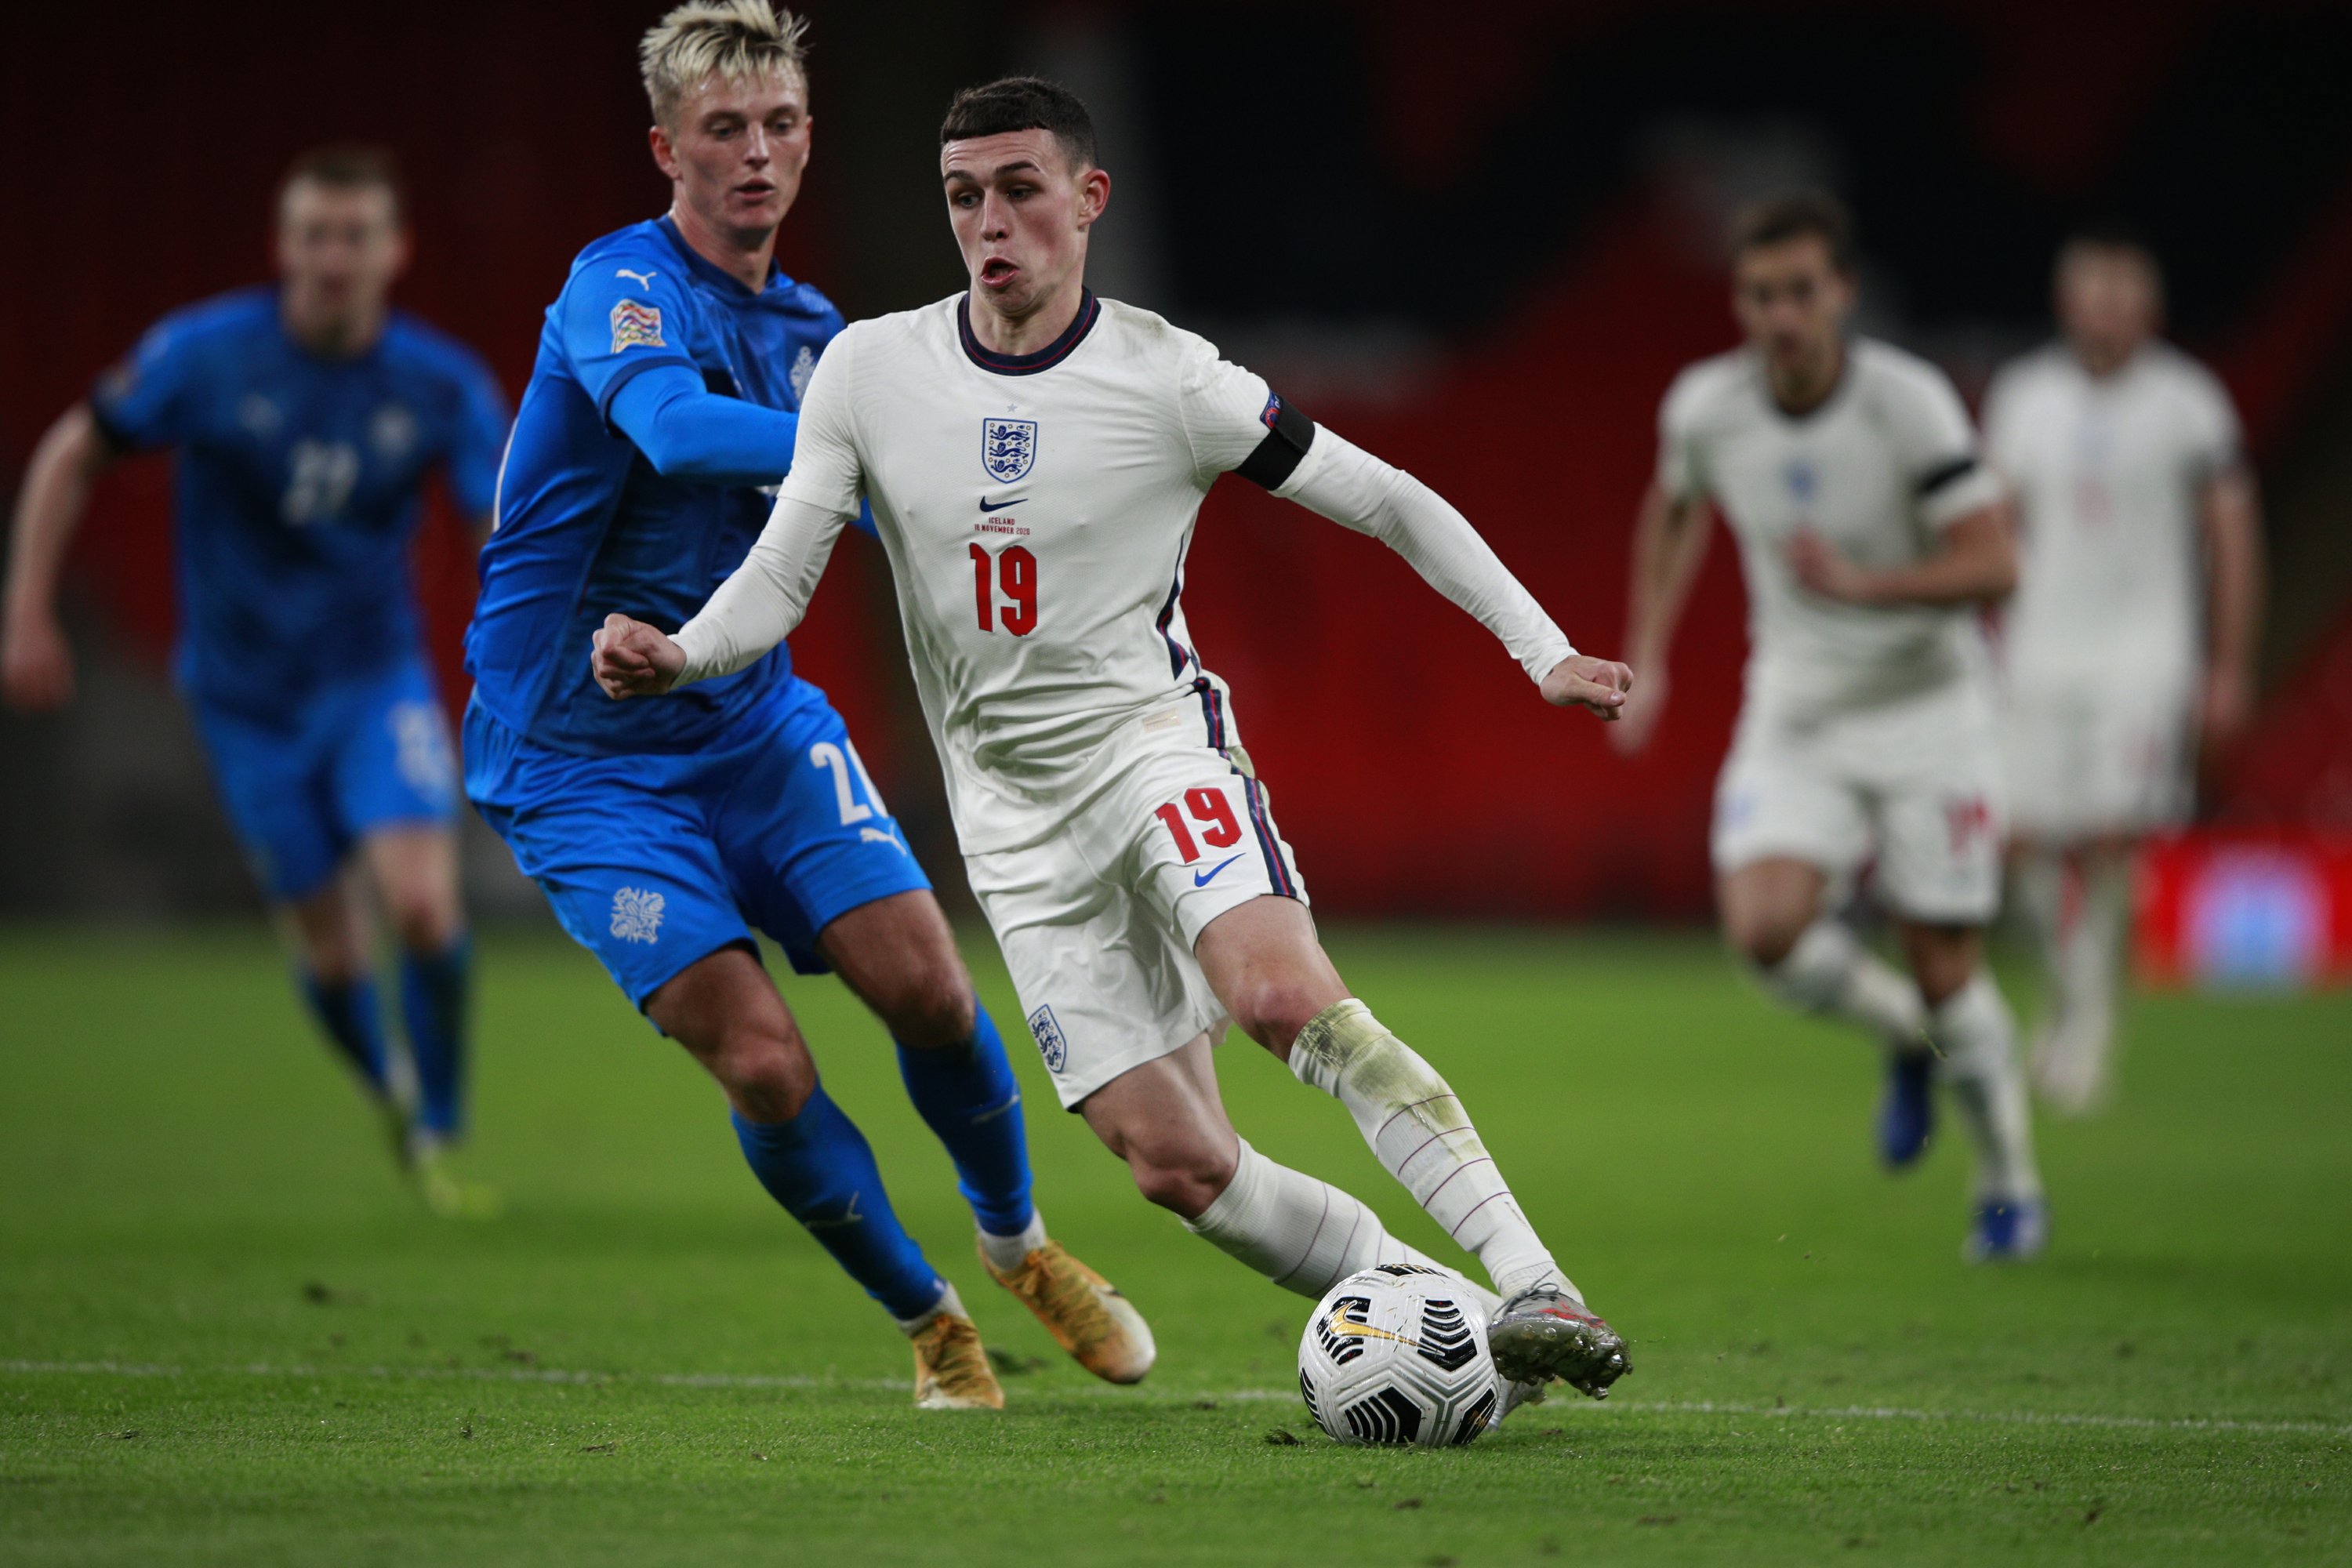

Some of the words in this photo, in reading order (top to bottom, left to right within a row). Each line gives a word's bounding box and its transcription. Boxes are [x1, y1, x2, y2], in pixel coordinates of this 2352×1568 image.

[982, 524, 1014, 534] NOVEMBER
[989, 517, 1015, 525] ICELAND
[969, 542, 1037, 637] 19
[1154, 787, 1243, 865] 19
